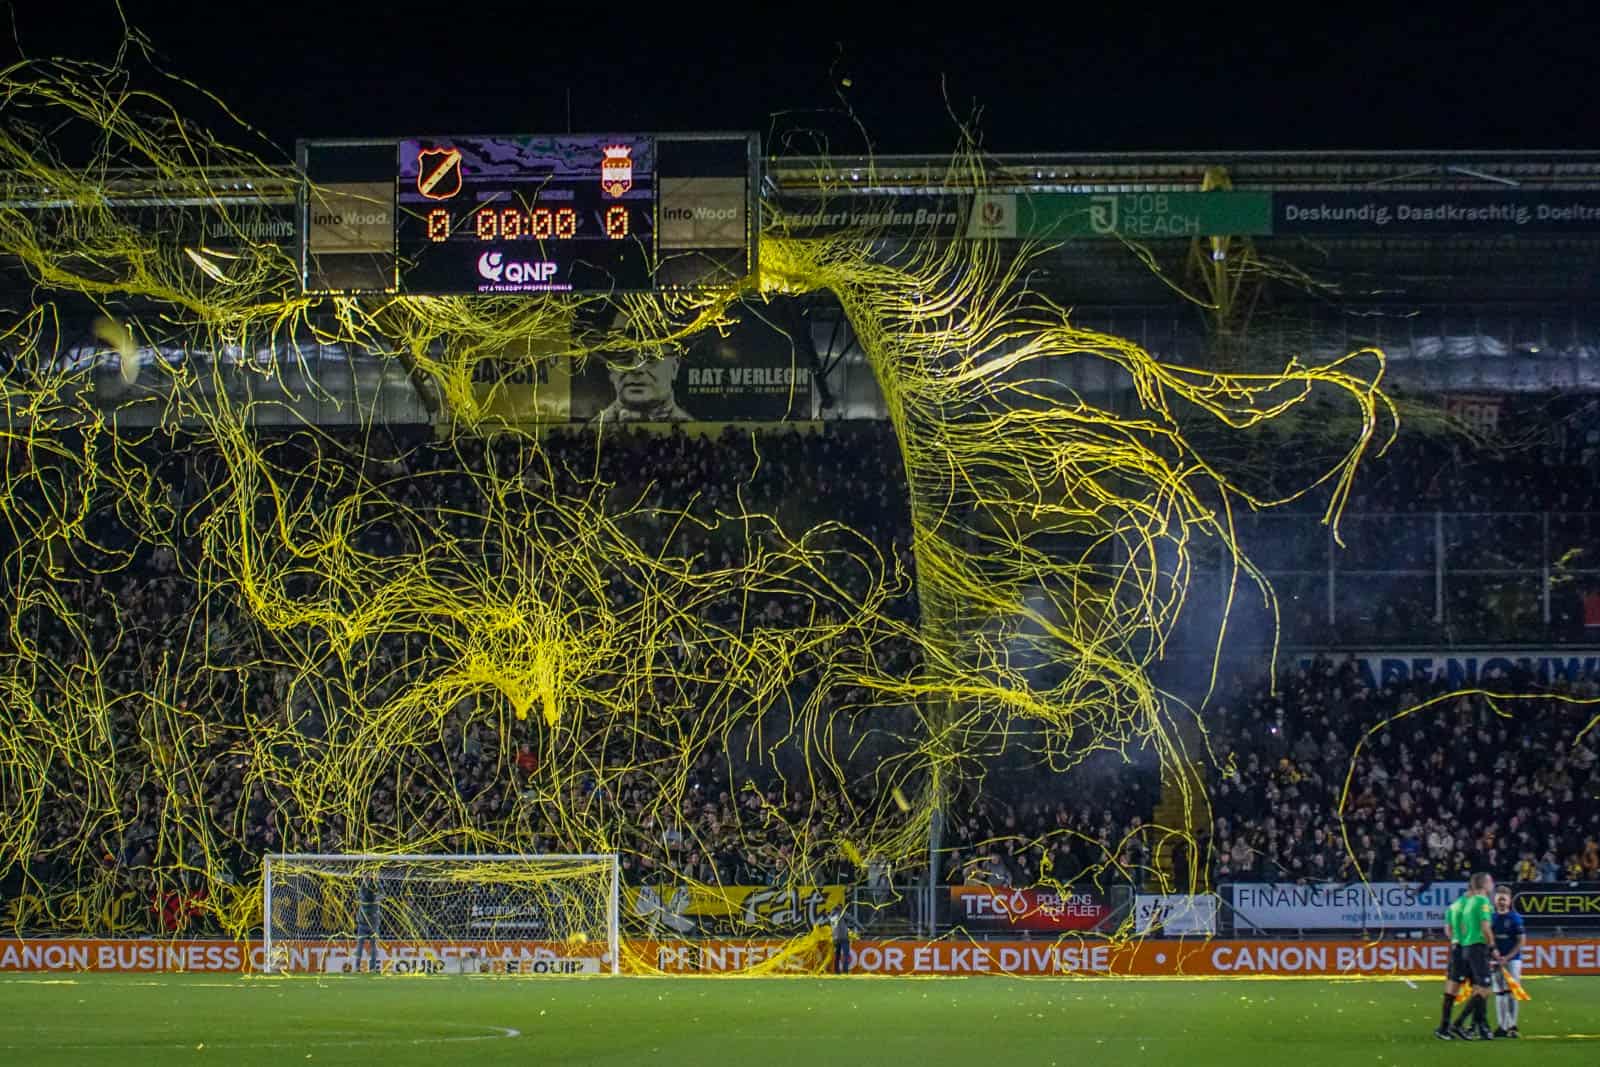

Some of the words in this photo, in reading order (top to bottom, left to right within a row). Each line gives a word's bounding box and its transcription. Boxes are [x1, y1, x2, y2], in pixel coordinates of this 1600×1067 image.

[1124, 194, 1170, 213] JOB
[427, 208, 451, 242] 0
[476, 209, 576, 240] 00:00
[606, 206, 630, 239] 0
[1124, 214, 1201, 234] REACH
[1285, 205, 1392, 225] Deskundig.
[1397, 205, 1531, 225] Daadkrachtig.
[505, 262, 558, 284] QNP
[688, 368, 724, 385] RAT
[729, 368, 809, 385] VERLEGH
[1067, 905, 1102, 918] FLEET
[1426, 910, 1445, 921] fina
[97, 945, 240, 969] BUSINESS
[832, 947, 905, 971] OOR
[914, 947, 990, 971] ELKE
[1000, 947, 1110, 971] DIVISIE
[1211, 946, 1328, 971] CANON
[1336, 946, 1449, 971] BUSINE
[1520, 946, 1600, 971] ENTE
